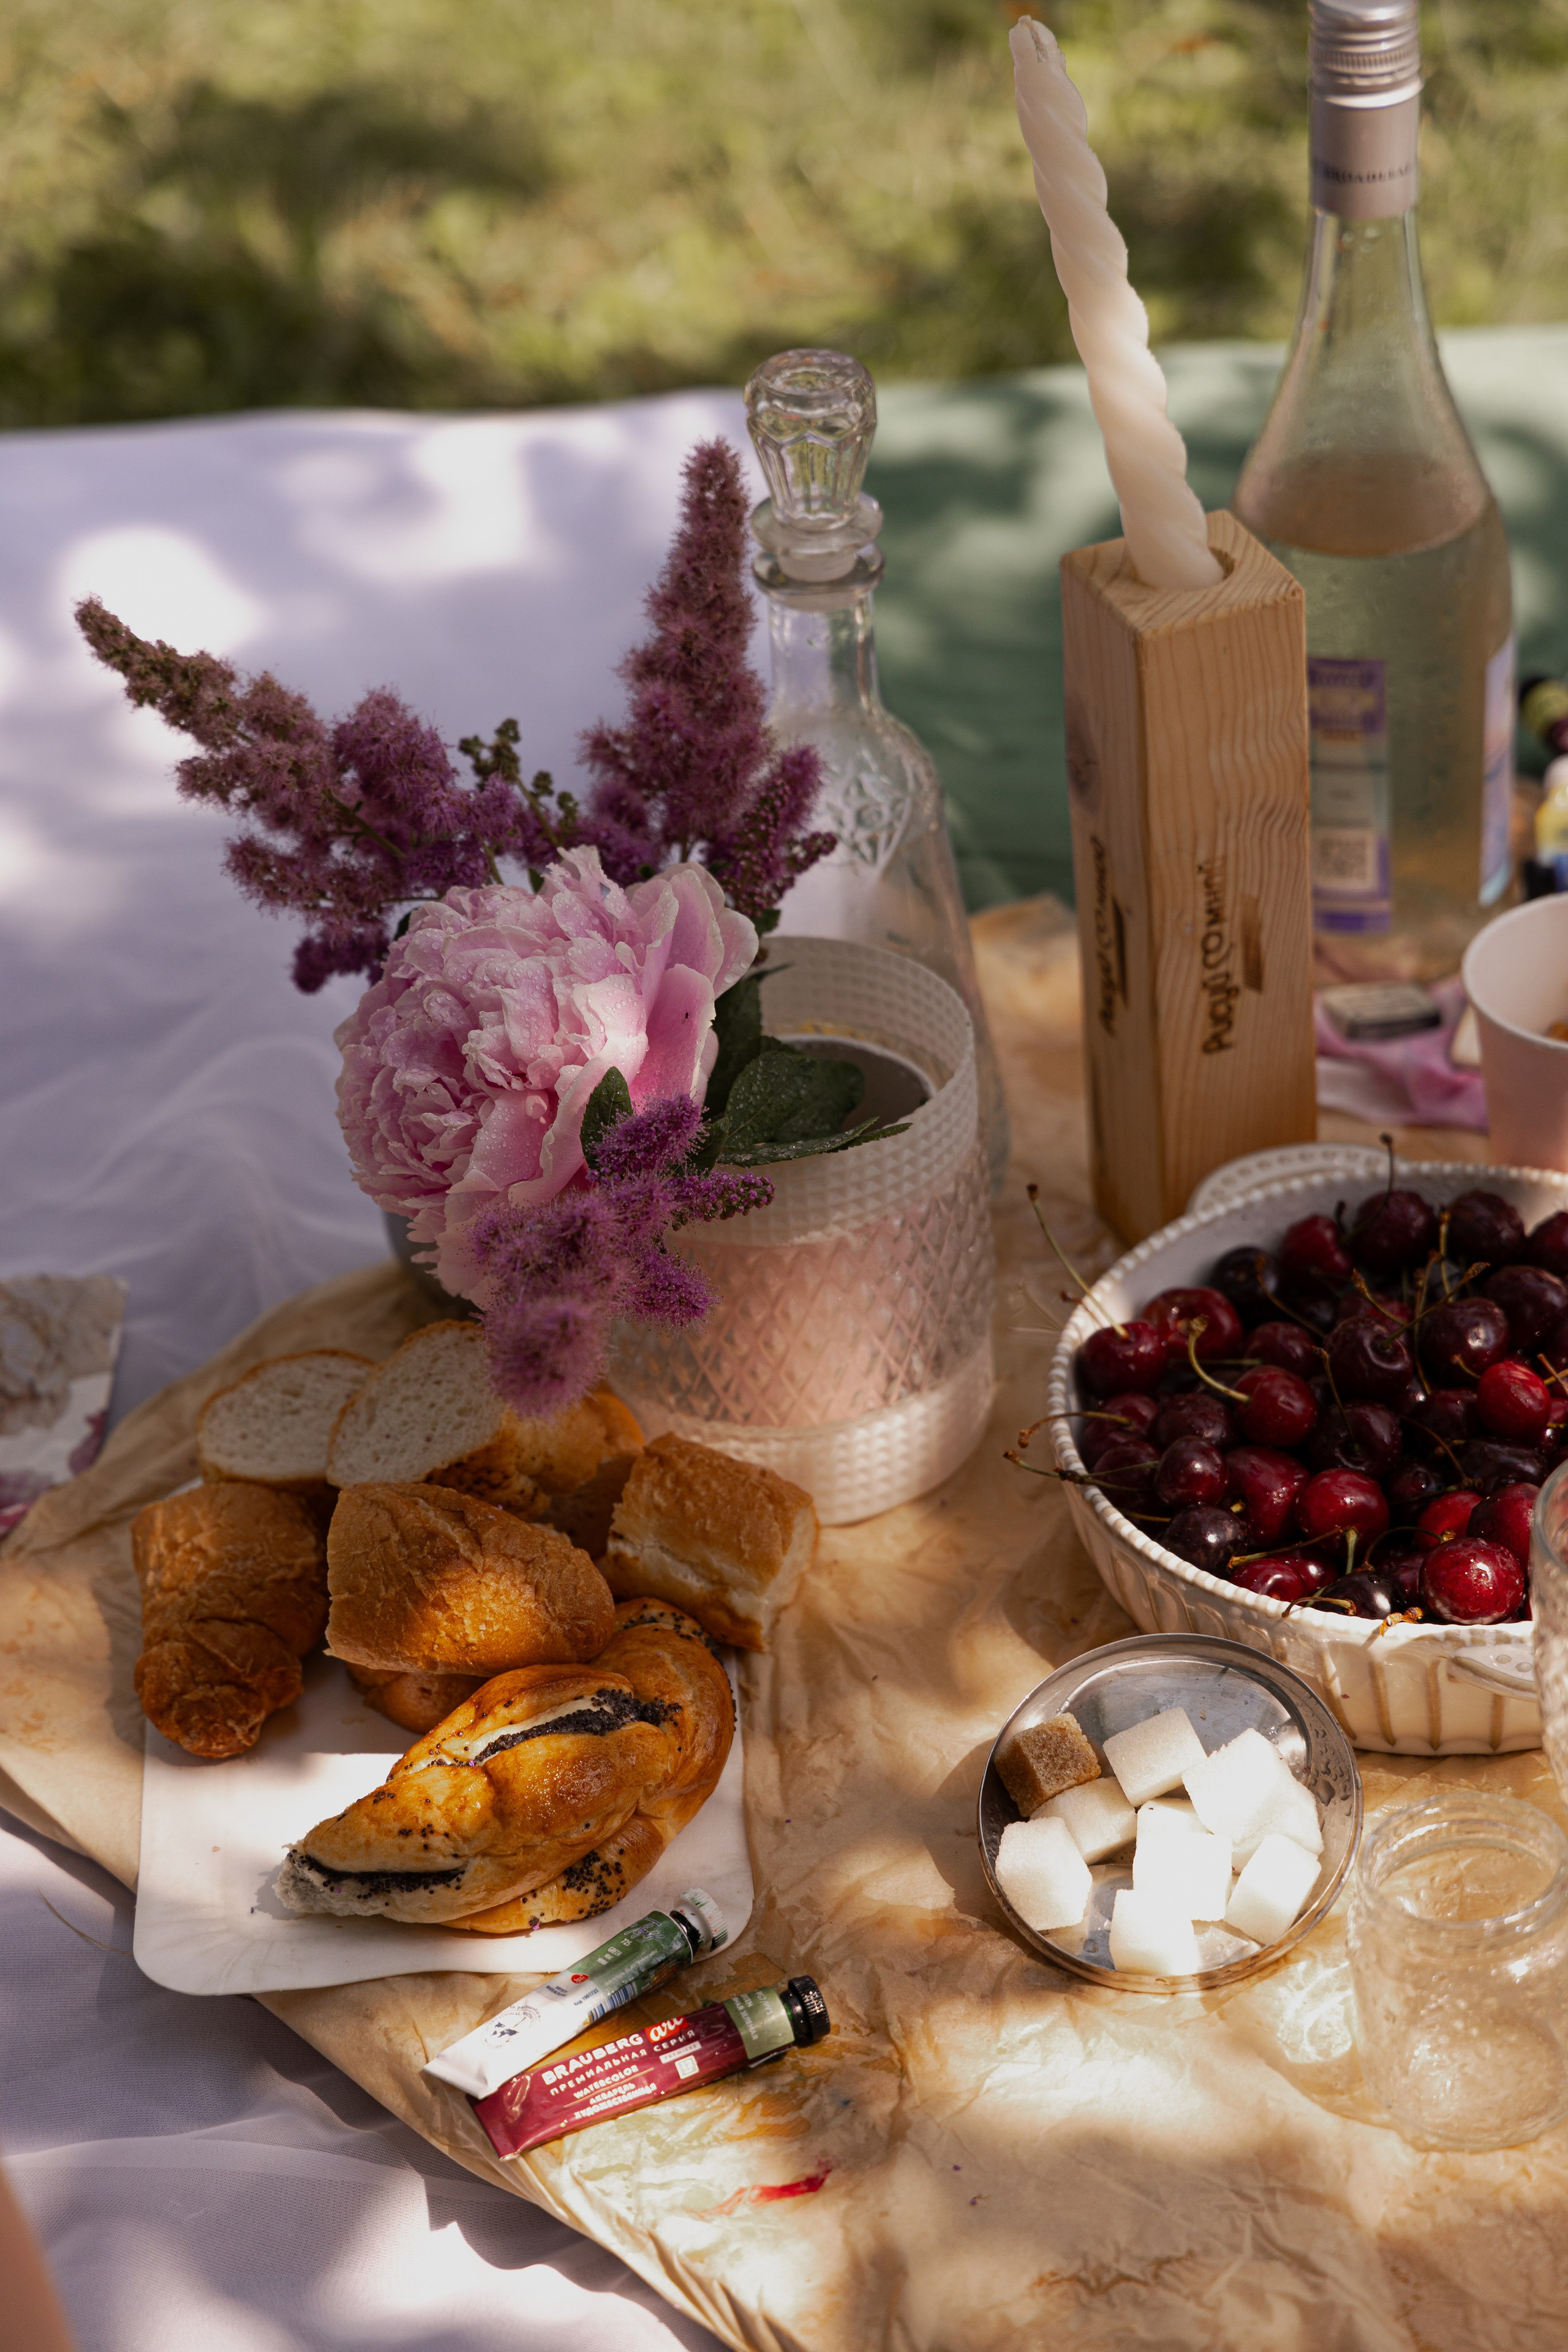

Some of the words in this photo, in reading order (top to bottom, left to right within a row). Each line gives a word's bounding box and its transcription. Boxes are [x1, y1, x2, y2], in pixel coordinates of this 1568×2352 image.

[608, 1947, 622, 1956] GREEN
[620, 1938, 632, 1947] 725
[740, 2010, 758, 2040] ЗЕЛЕНАЯ
[541, 2034, 644, 2085] BRAUBERG
[549, 2049, 647, 2096] ПРЕМИАЛЬНАЯ
[653, 2030, 695, 2052] СЕРИЯ
[679, 2059, 693, 2070] 12
[573, 2065, 639, 2099] WATERCOLOR
[589, 2082, 636, 2105] АКВАРЕЛЬ
[574, 2082, 658, 2119] ХУДОЖЕСТВЕННАЯ
